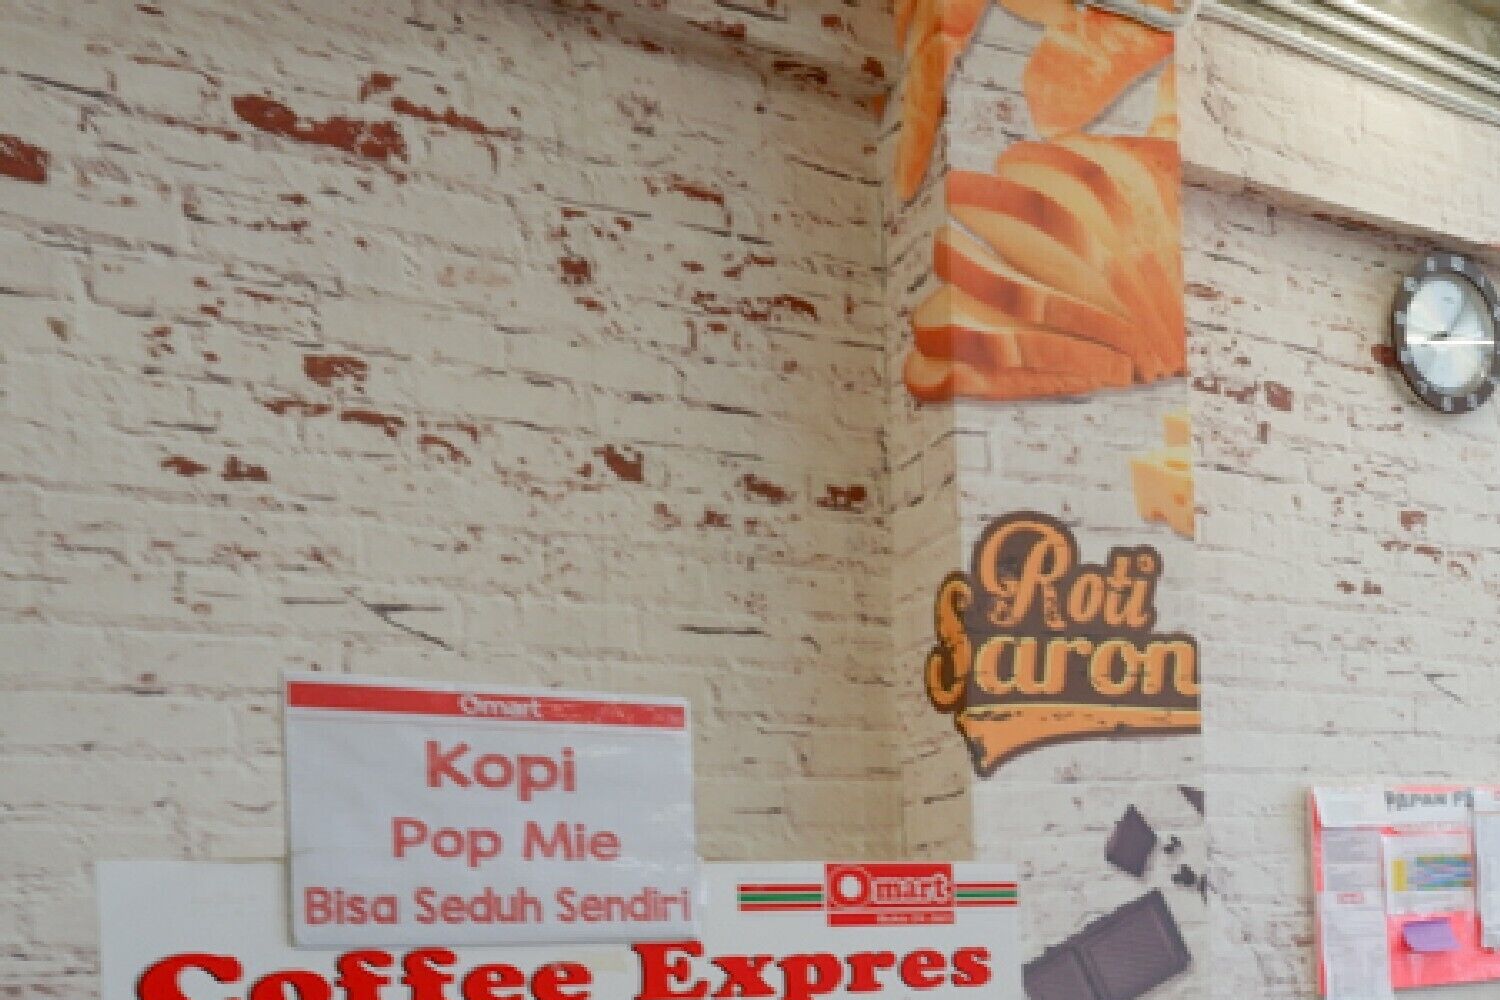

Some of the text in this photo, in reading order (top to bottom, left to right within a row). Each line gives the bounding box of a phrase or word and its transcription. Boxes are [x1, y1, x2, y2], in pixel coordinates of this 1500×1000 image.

[974, 513, 1160, 630] Roti
[925, 572, 1201, 713] Saron
[459, 694, 543, 720] Omart
[426, 741, 577, 802] Kopi
[392, 815, 622, 869] Pop Mie
[304, 886, 692, 926] Bisa Seduh Sendiri
[829, 866, 948, 907] Omart
